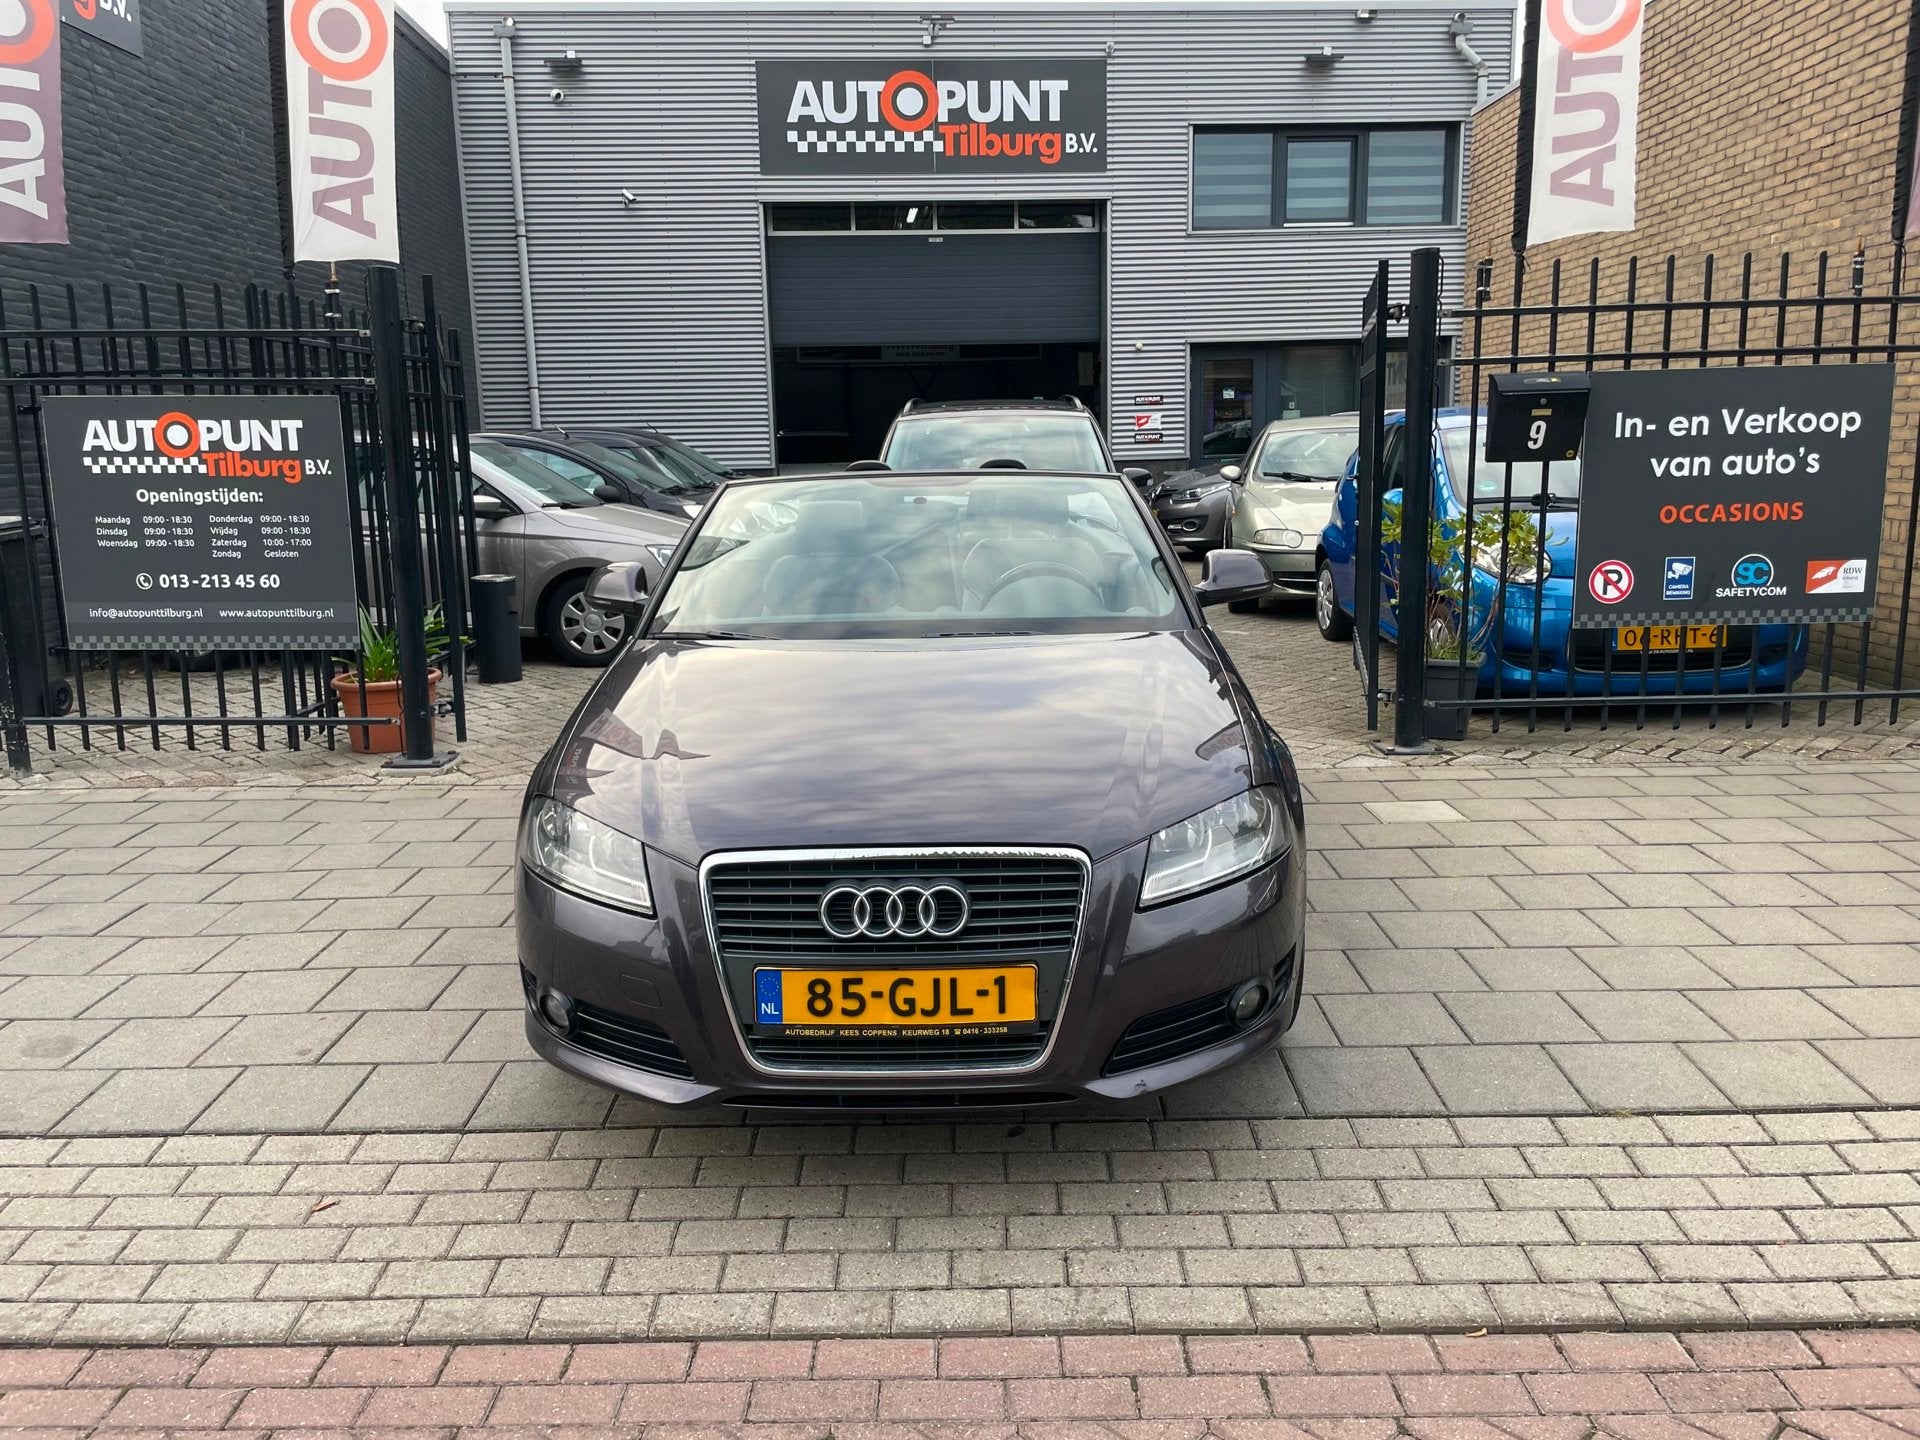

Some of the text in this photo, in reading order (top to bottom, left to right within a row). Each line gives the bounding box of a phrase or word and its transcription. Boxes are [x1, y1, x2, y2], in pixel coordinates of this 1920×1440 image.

[787, 70, 1069, 133] AUTOPUNT
[938, 123, 1099, 165] Tilburg B.V.
[1614, 406, 1862, 438] In- en Verkoop
[82, 412, 304, 459] AUTOPUNT
[1527, 420, 1547, 450] 9
[201, 451, 332, 484] Tilburg B.V.
[1650, 447, 1821, 478] van auto's
[136, 488, 264, 504] Openingstijden:
[1659, 502, 1804, 524] OCCASIONS
[95, 516, 131, 525] Maandag
[143, 515, 163, 523] 09:00
[171, 515, 192, 523] 18:30
[209, 515, 253, 525] Donderdag
[260, 515, 280, 523] 09:00
[288, 515, 310, 523] 18:30
[96, 528, 128, 537] Dinsdag
[144, 527, 164, 535] 09:00
[172, 527, 194, 535] 18:30
[210, 527, 238, 536] Vrijdag
[261, 527, 281, 535] 09:00
[289, 527, 311, 535] 18:30
[97, 539, 138, 549] Woensdag
[145, 539, 166, 547] 09:00
[174, 539, 195, 547] 18:30
[211, 538, 247, 548] Zaterdag
[263, 538, 283, 546] 10:00
[291, 538, 312, 546] 17:00
[212, 550, 299, 559] Zondag Gesloten
[1843, 567, 1863, 575] RDW
[235, 574, 256, 588] 45
[259, 574, 280, 588] 60
[1715, 586, 1787, 598] SAFETYCOM
[89, 608, 203, 618] info@autopunttilburg.nl
[219, 608, 334, 618] www.autopunttilburg.nl
[806, 975, 1006, 1018] 85-GJL-1
[761, 1002, 779, 1015] NL
